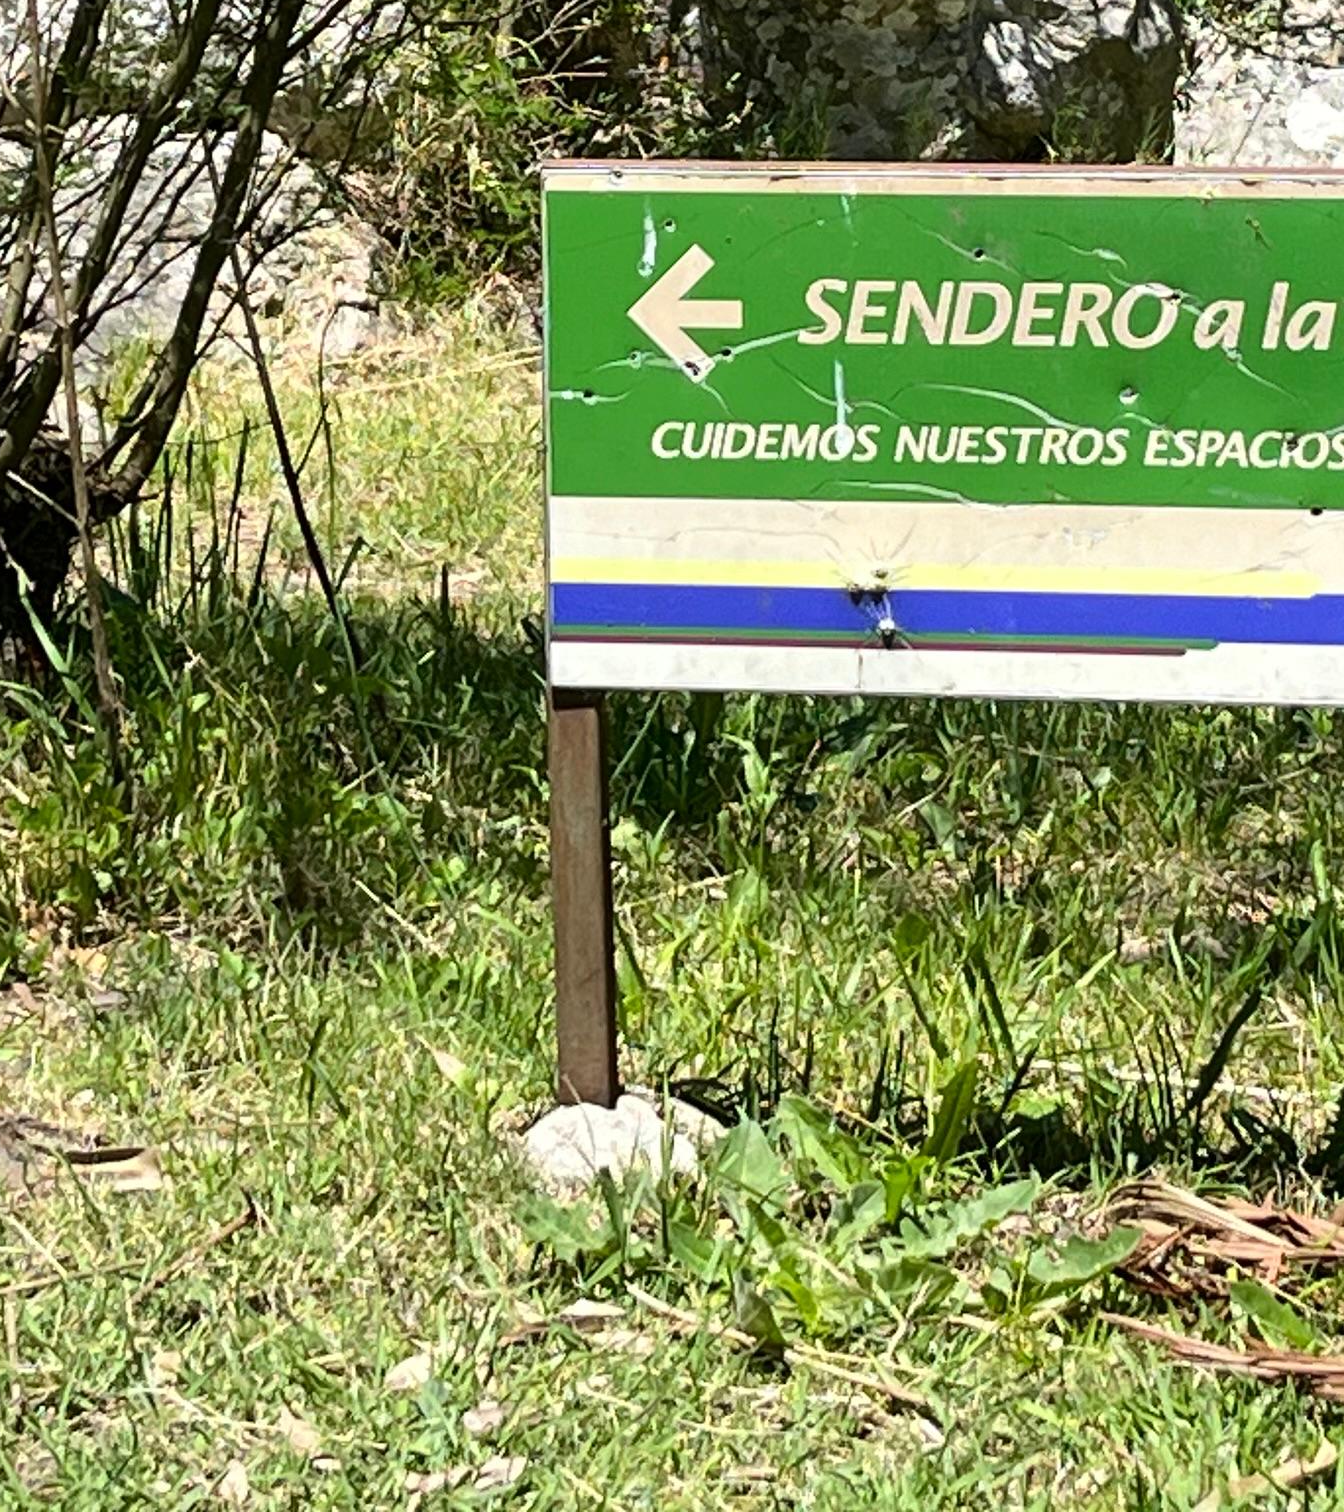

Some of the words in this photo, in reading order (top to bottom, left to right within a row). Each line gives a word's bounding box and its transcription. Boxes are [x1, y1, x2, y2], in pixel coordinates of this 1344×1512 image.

[797, 277, 1182, 349] SENDERO
[1193, 299, 1246, 351] a
[1261, 281, 1337, 352] la
[651, 420, 881, 464] CUIDEMOS
[893, 424, 1129, 466] NUESTROS
